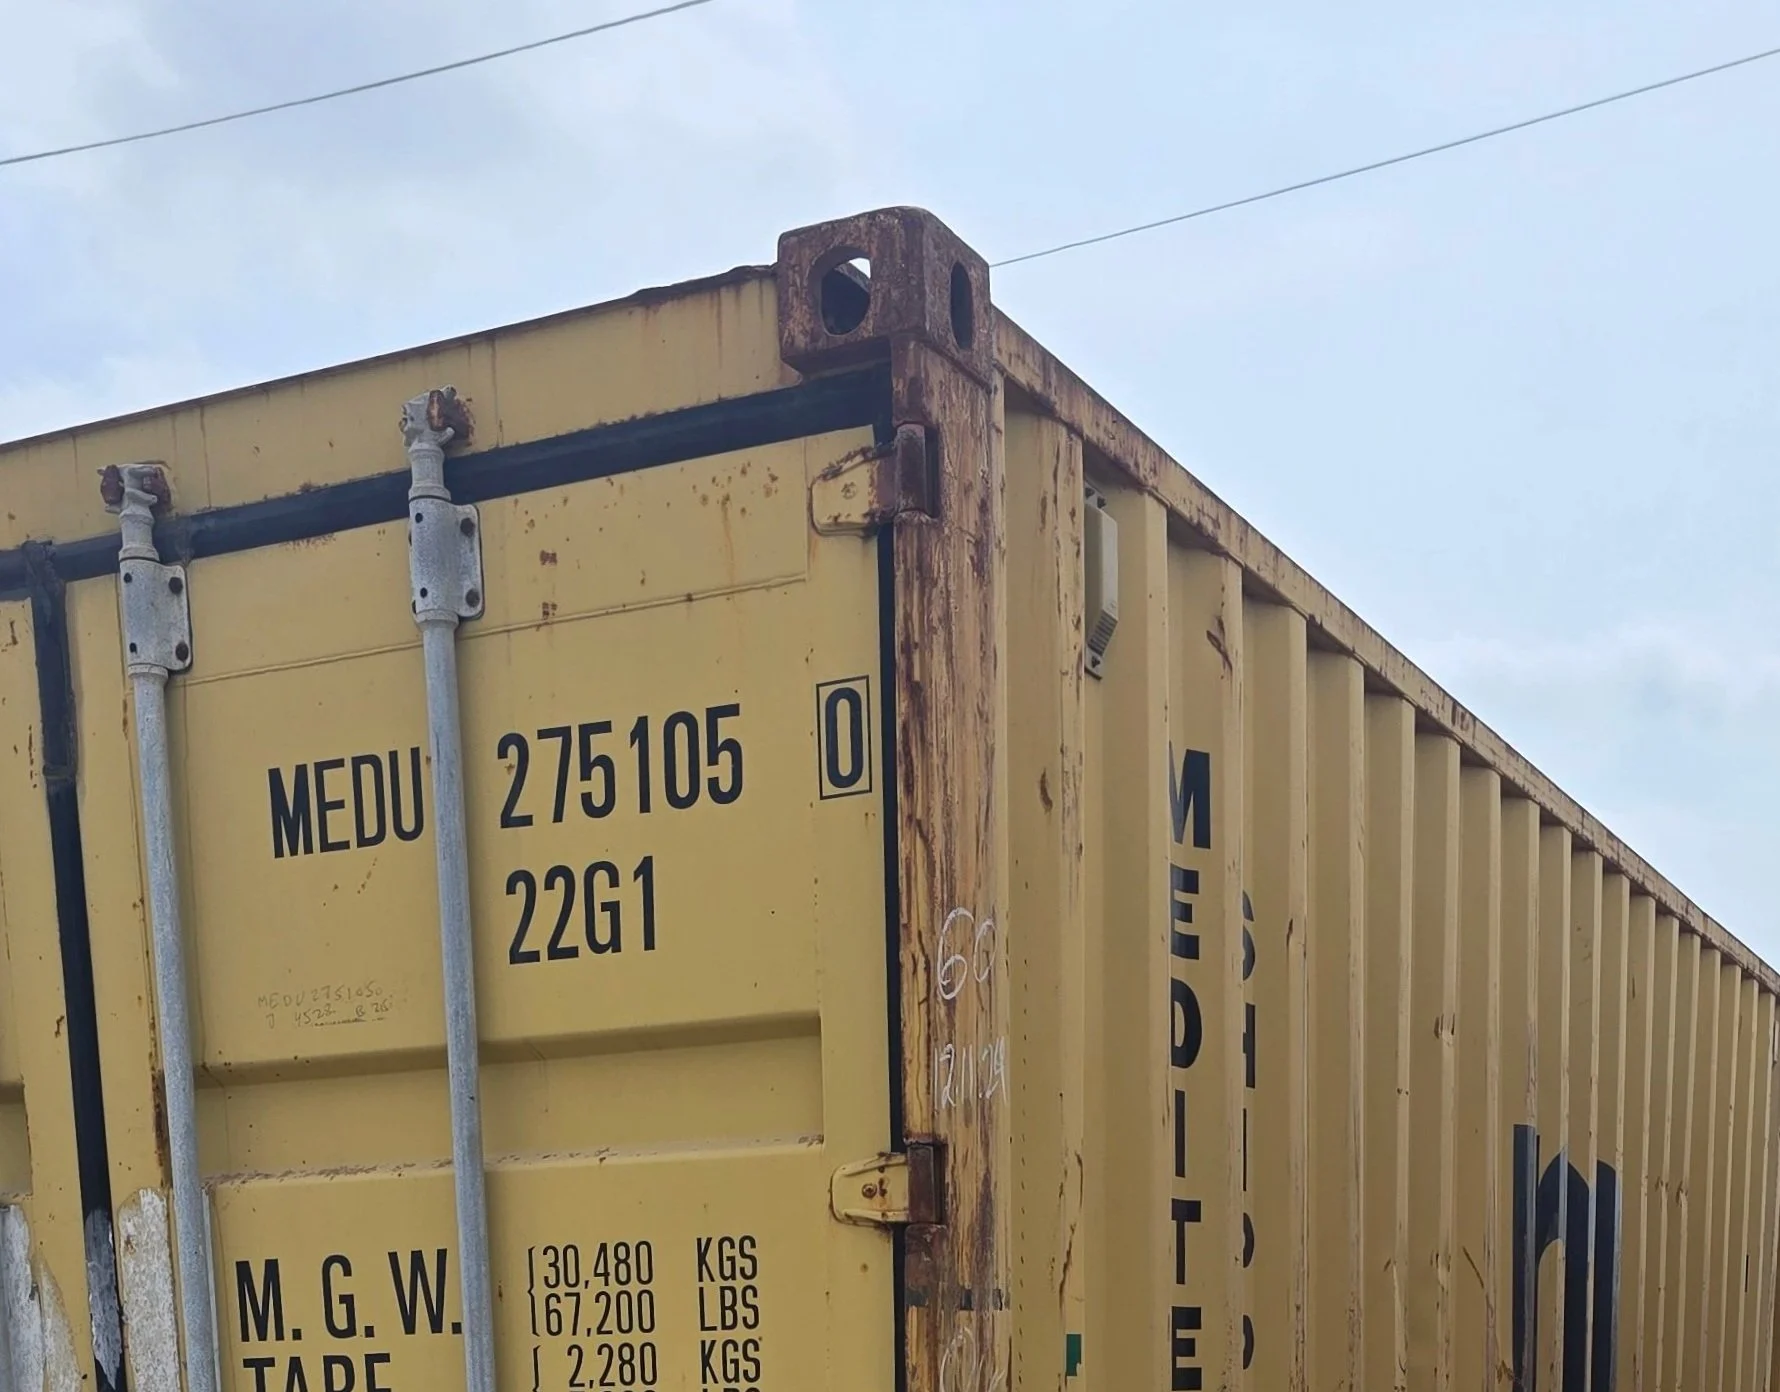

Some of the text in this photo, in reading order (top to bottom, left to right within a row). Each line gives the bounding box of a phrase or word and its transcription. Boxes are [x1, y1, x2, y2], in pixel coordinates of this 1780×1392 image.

[267, 686, 865, 859] MEDU 275105 0
[506, 855, 656, 965] 22G1
[542, 1235, 758, 1290] 30,480 KGS
[544, 1285, 760, 1337] 67,200 LBS
[566, 1338, 761, 1389] 2,280 KGS
